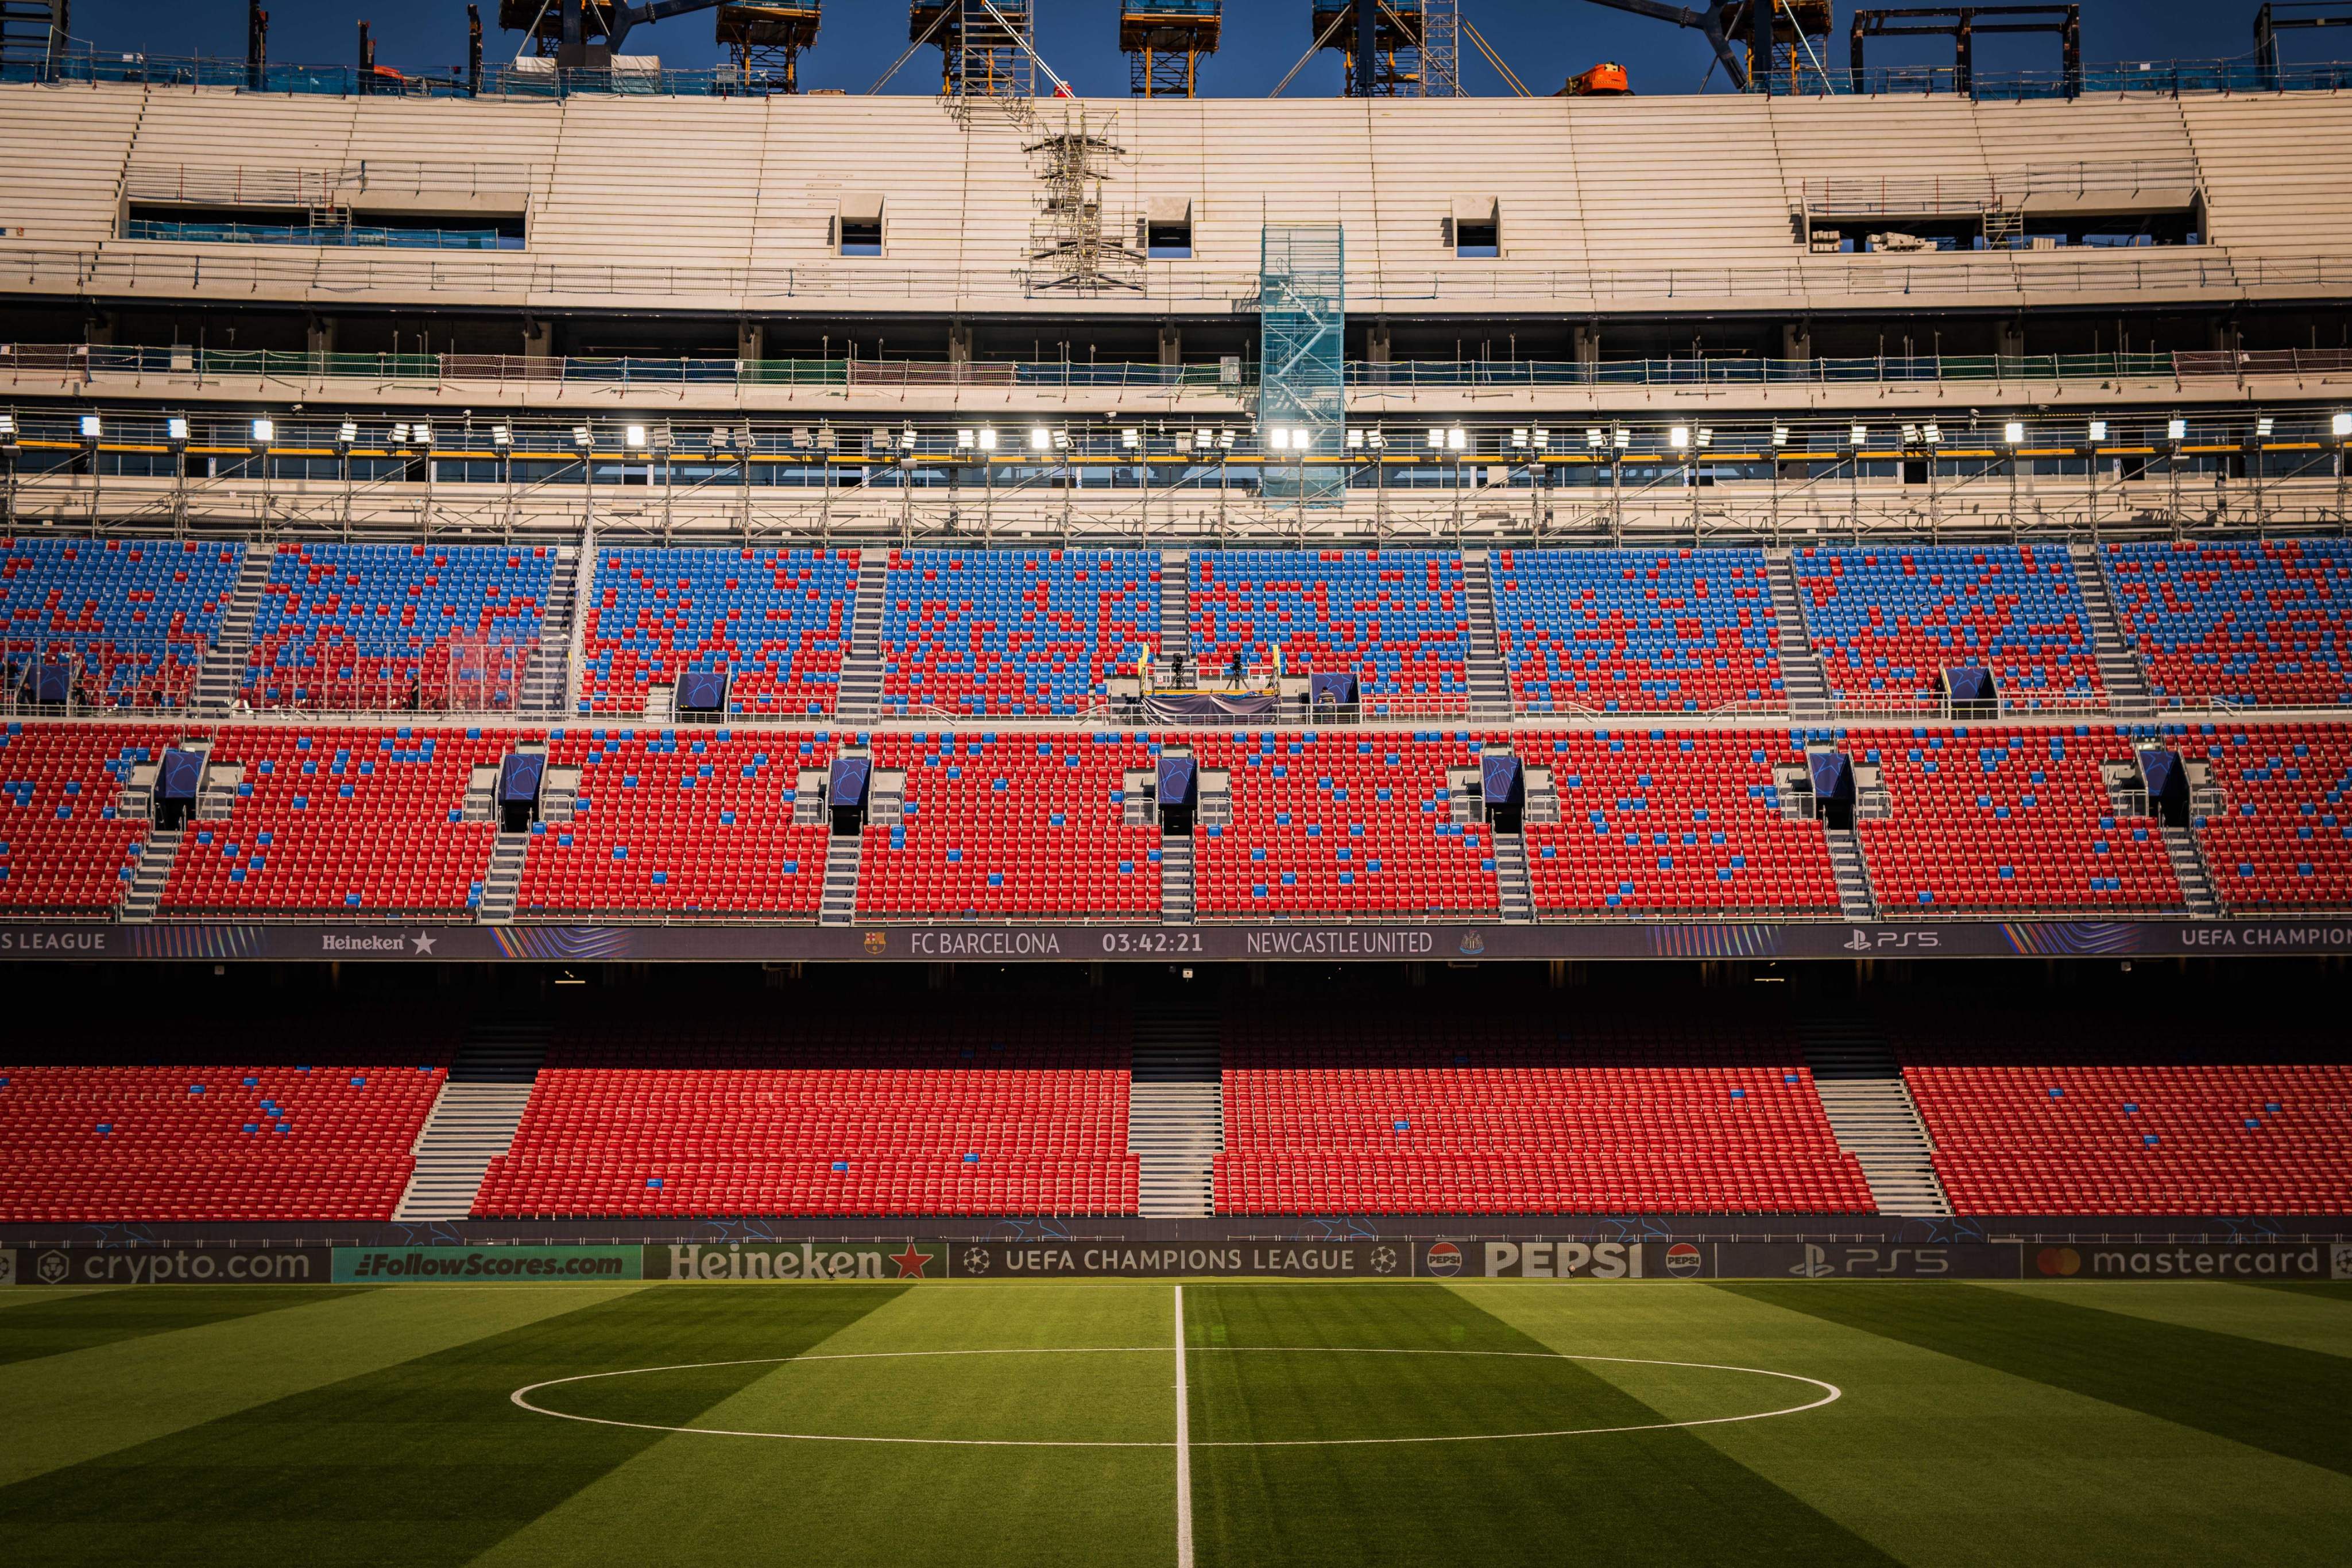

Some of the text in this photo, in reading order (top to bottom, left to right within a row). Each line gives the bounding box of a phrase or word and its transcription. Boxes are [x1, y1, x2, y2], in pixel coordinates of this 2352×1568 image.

[20, 932, 106, 949] LEAGUE
[912, 933, 1060, 954] FC BARCELONA
[1102, 933, 1202, 953] 03:42:21
[1247, 932, 1433, 953] NEWCASTLE UNITED
[1877, 932, 1939, 947] PS5
[2181, 929, 2236, 946] UEFA
[84, 1253, 310, 1284] crypto.com
[668, 1244, 885, 1278] Heineken
[1006, 1249, 1354, 1270] UEFA CHAMPIONS LEAGUE
[1429, 1255, 1460, 1264] PEPSI
[1485, 1242, 1642, 1278] PEPSI
[1668, 1256, 1699, 1264] PEPSI
[1846, 1249, 1948, 1273] PS5
[2094, 1247, 2318, 1273] mastercard
